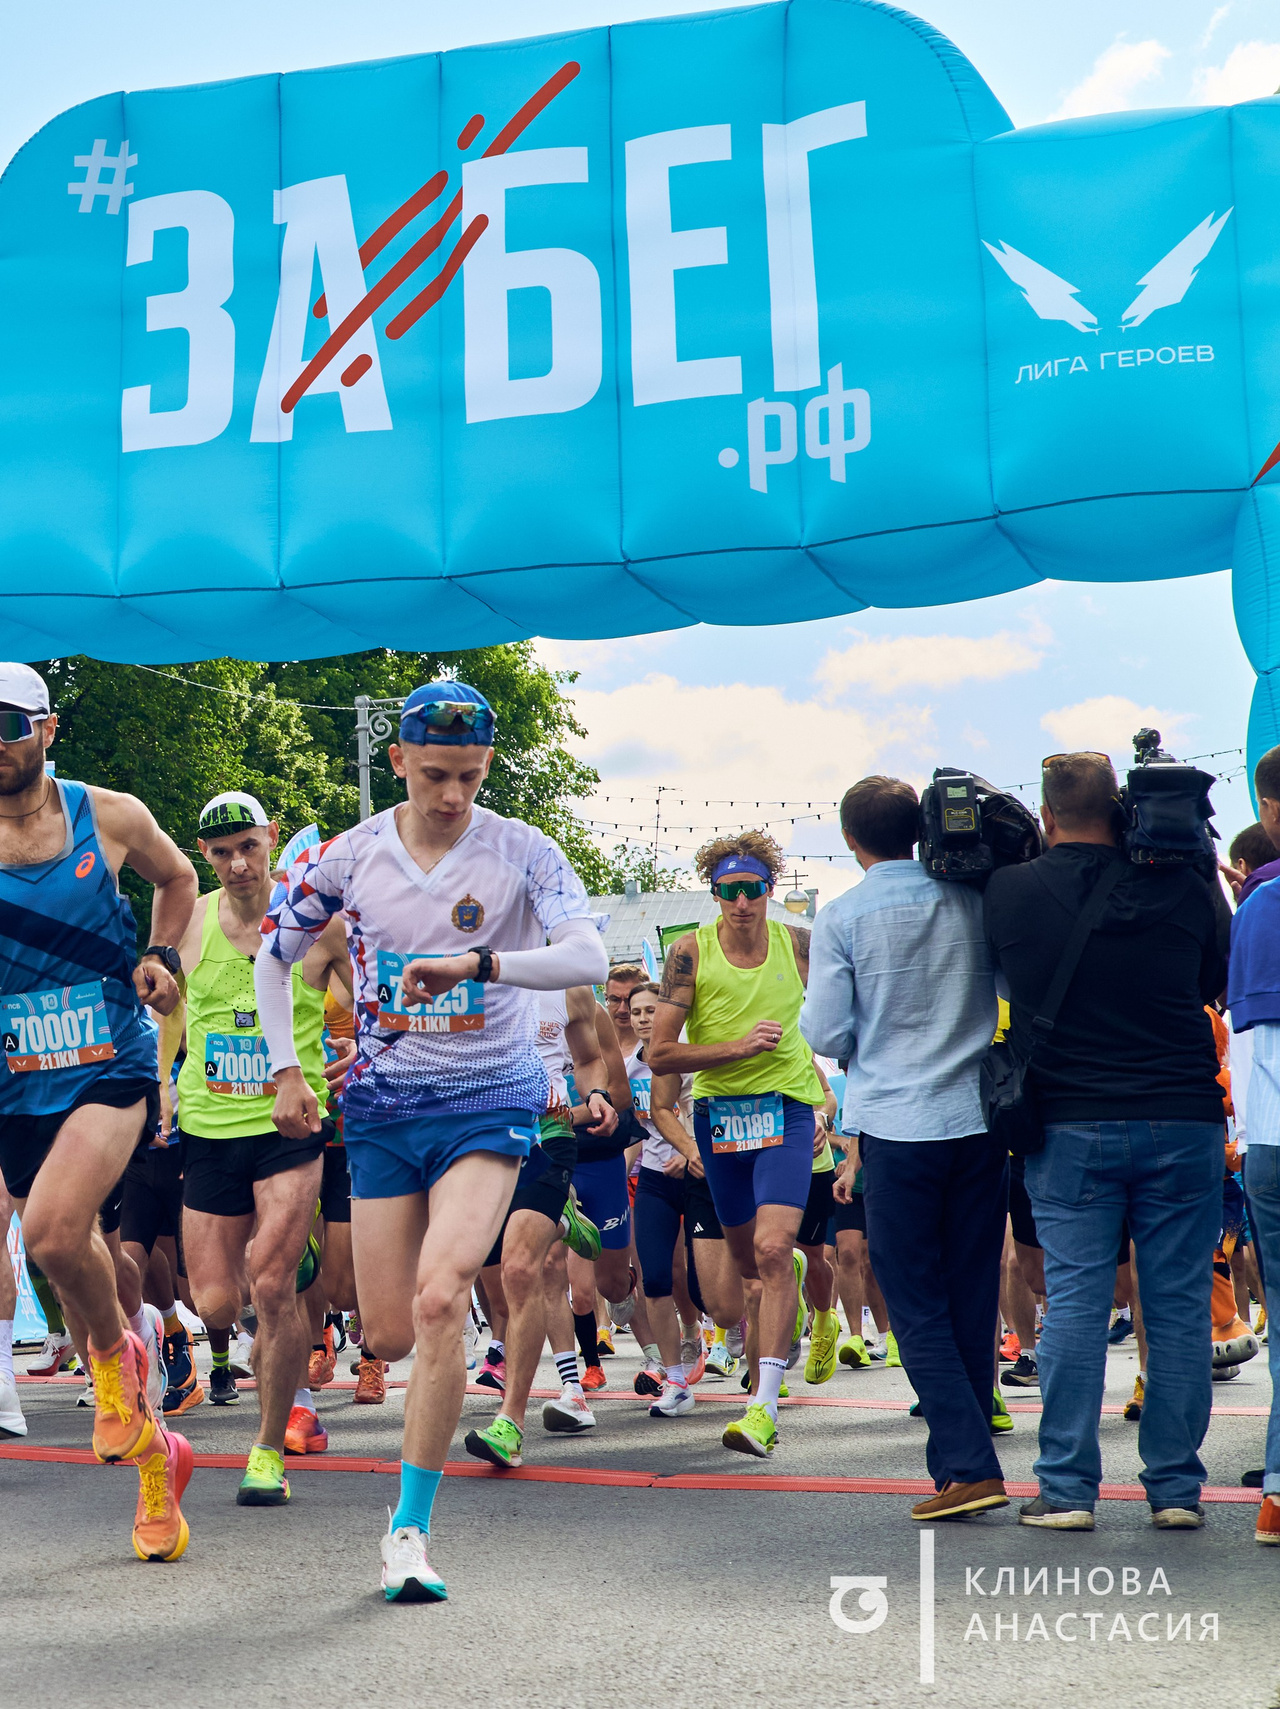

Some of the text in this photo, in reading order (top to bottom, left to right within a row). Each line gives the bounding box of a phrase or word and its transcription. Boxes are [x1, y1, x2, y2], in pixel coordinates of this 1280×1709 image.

[1015, 345, 1215, 384] ЛИГА ГЕРОЕВ
[389, 974, 469, 1014] 725
[10, 1006, 96, 1054] 70007
[38, 1049, 81, 1071] 21.1KM
[720, 1111, 775, 1141] 70189
